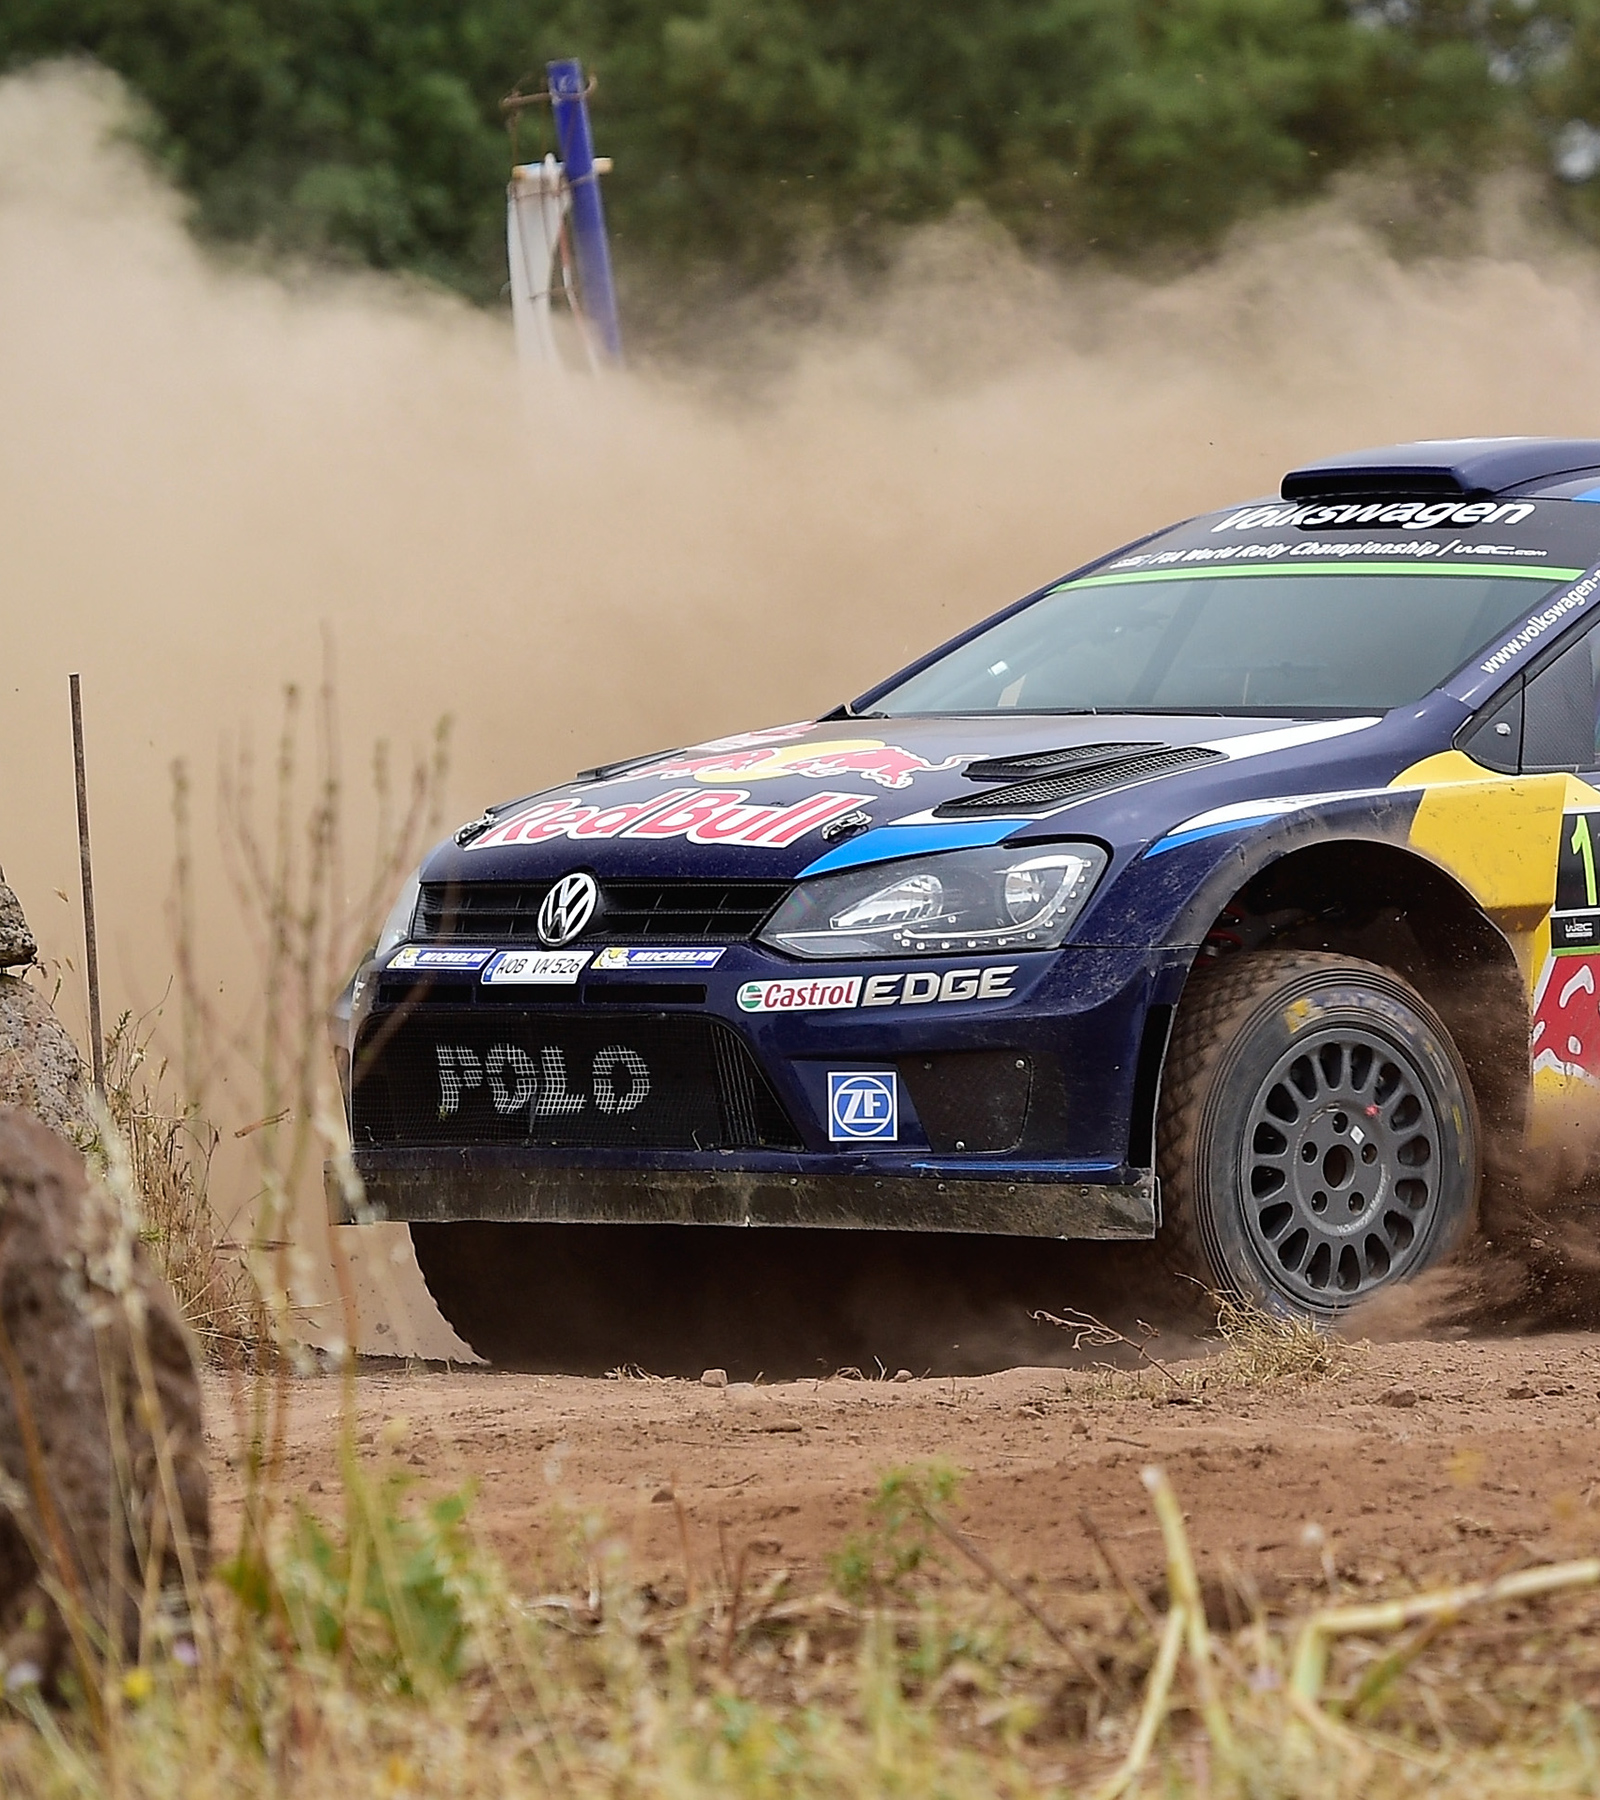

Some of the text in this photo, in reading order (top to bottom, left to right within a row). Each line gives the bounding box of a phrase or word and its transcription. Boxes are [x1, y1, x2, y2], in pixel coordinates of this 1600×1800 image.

[1210, 501, 1536, 534] Volkswagen
[1181, 545, 1243, 562] World
[1235, 543, 1290, 560] Rally
[1289, 540, 1444, 558] Championship
[470, 790, 872, 848] Red Bull
[1570, 815, 1597, 905] 1
[418, 952, 489, 962] MICHELIN
[550, 958, 583, 974] 526
[627, 951, 722, 963] MICHELIN
[764, 966, 1018, 1008] Castrol EDGE
[435, 1043, 652, 1115] POLO
